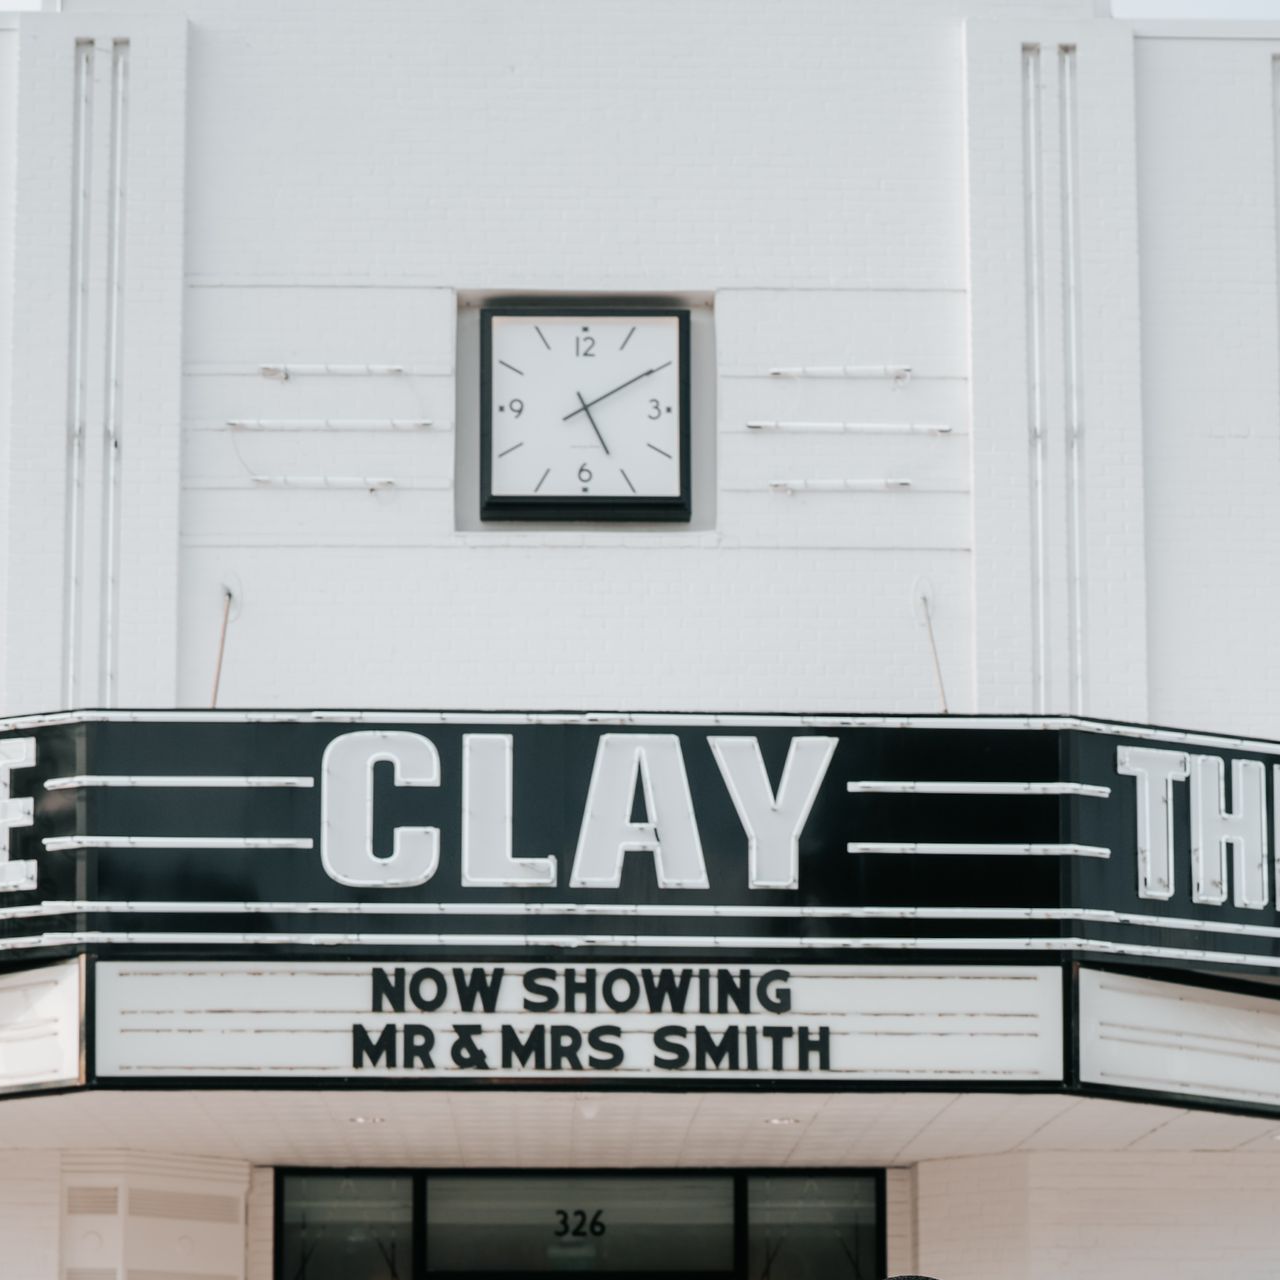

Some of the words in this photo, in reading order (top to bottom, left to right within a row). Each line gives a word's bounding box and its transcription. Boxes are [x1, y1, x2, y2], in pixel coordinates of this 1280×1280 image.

[575, 335, 596, 358] 12
[508, 397, 525, 419] 9
[647, 397, 663, 421] 3
[576, 461, 594, 484] 6
[321, 731, 839, 889] CLAY
[371, 967, 504, 1013] NOW
[522, 967, 793, 1014] SHOWING
[351, 1024, 436, 1070] MR
[451, 1025, 489, 1070] &
[500, 1024, 625, 1071] MRS
[653, 1025, 831, 1072] SMITH
[553, 1208, 607, 1237] 326
